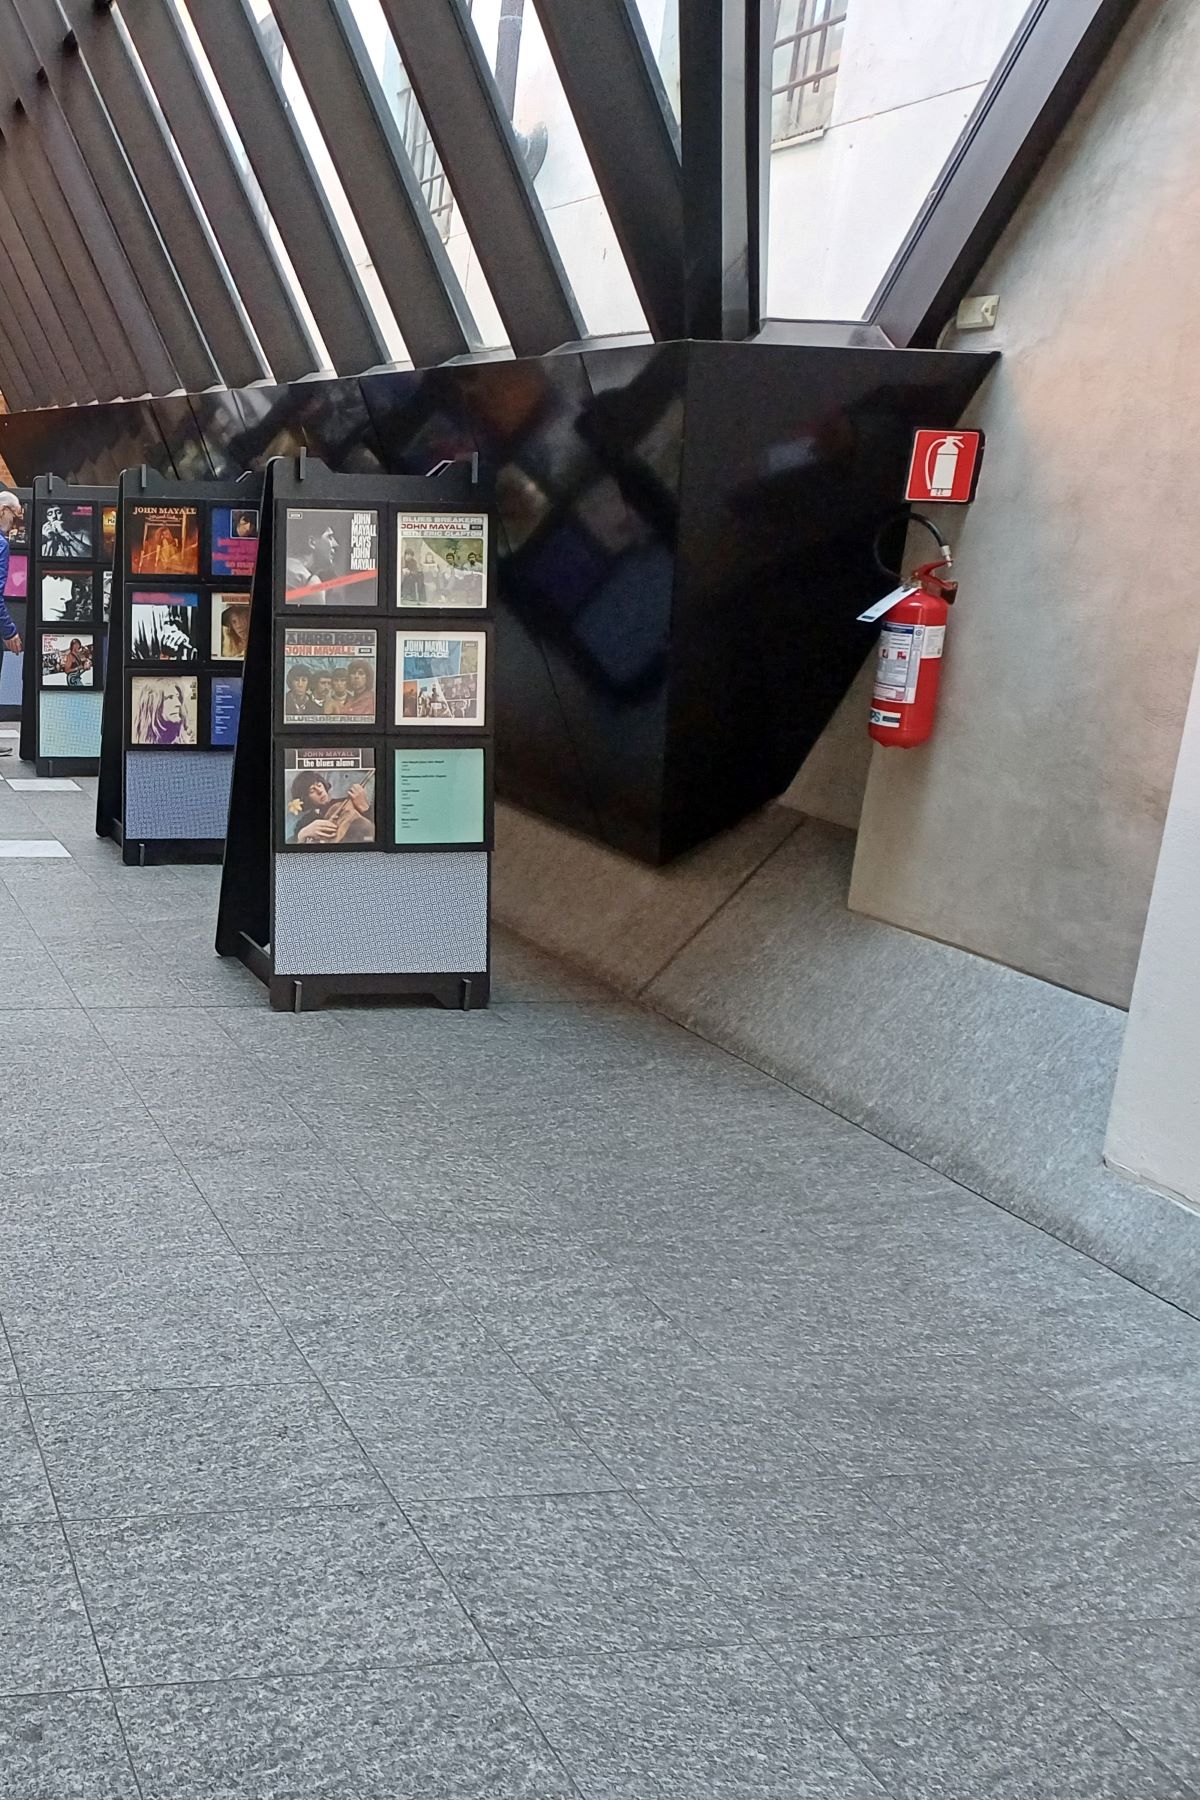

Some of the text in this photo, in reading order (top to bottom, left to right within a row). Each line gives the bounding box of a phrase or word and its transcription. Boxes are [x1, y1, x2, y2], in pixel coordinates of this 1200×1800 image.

[133, 506, 197, 515] JOHN MAYALL
[352, 513, 371, 525] JOHN
[351, 524, 377, 536] MAYALL
[351, 536, 371, 548] PLAYS
[351, 547, 370, 559] JOHN
[351, 558, 377, 570] MAYALL
[286, 645, 312, 656] JOHN
[405, 640, 424, 652] JOHN
[303, 759, 315, 767] the
[315, 758, 334, 767] blues
